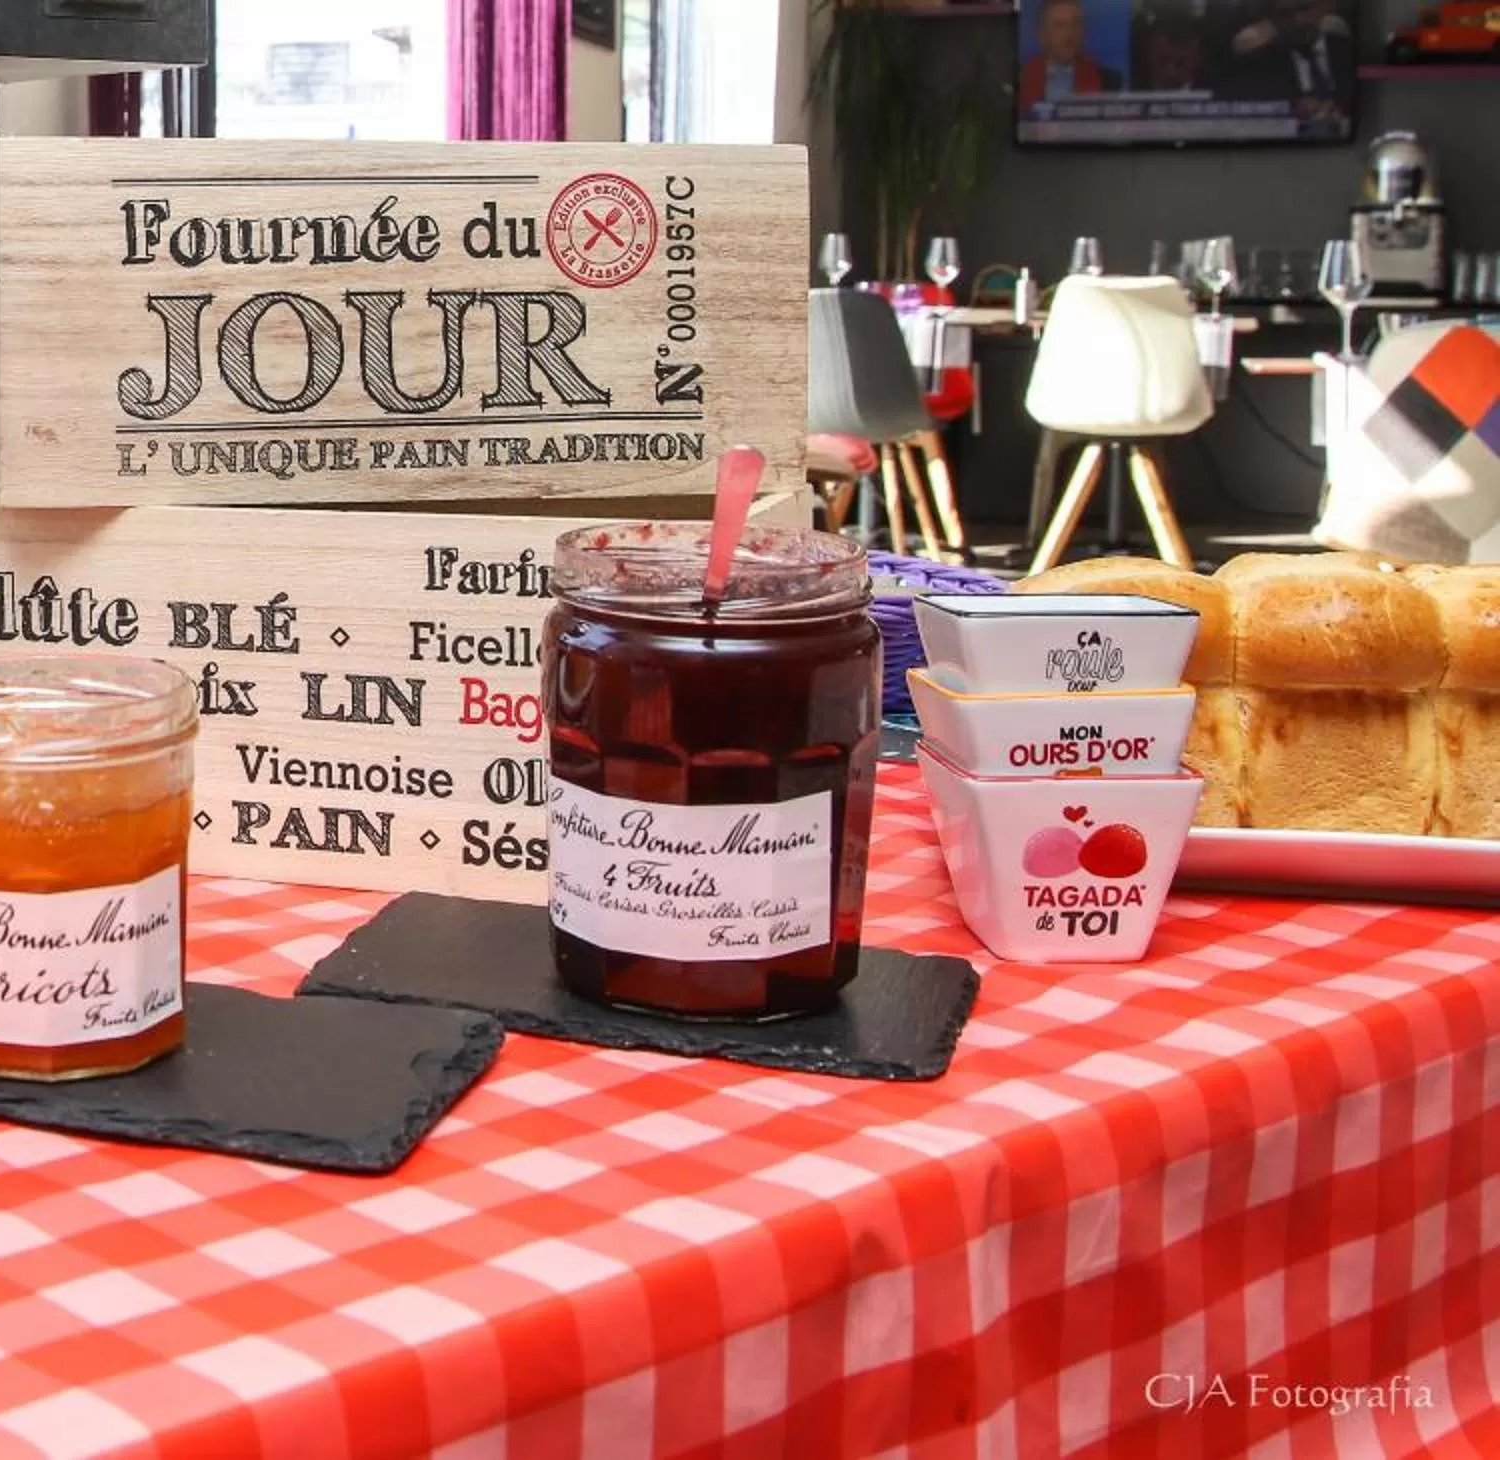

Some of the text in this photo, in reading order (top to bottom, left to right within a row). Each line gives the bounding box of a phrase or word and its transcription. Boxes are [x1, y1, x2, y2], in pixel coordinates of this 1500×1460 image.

[554, 184, 647, 231] Edition exclusive
[121, 196, 541, 268] Fournée du
[560, 242, 646, 279] La Brasserie
[665, 176, 696, 341] 0001957C
[117, 289, 611, 420] JOUR
[171, 438, 358, 480] UNIQUE
[369, 437, 469, 469] PAIN
[480, 432, 705, 467] TRADITION
[168, 591, 300, 654] BLÉ
[409, 621, 541, 667] Ficell
[1077, 631, 1101, 649] ÇA
[1046, 636, 1124, 682] roule
[195, 661, 544, 743] ix LIN Bag
[1009, 743, 1079, 767] OURS
[1059, 725, 1102, 741] MON
[236, 744, 453, 799] Viennoise
[231, 800, 550, 872] PAIN Sés
[618, 810, 707, 855] Bonne
[710, 812, 817, 855] Maman
[603, 860, 721, 898] 4 Fruits
[1023, 885, 1143, 908] TAGADA
[76, 896, 170, 946] Maman
[707, 925, 760, 947] Fruits
[1035, 910, 1120, 937] de TOI
[83, 1002, 138, 1030] Fruits
